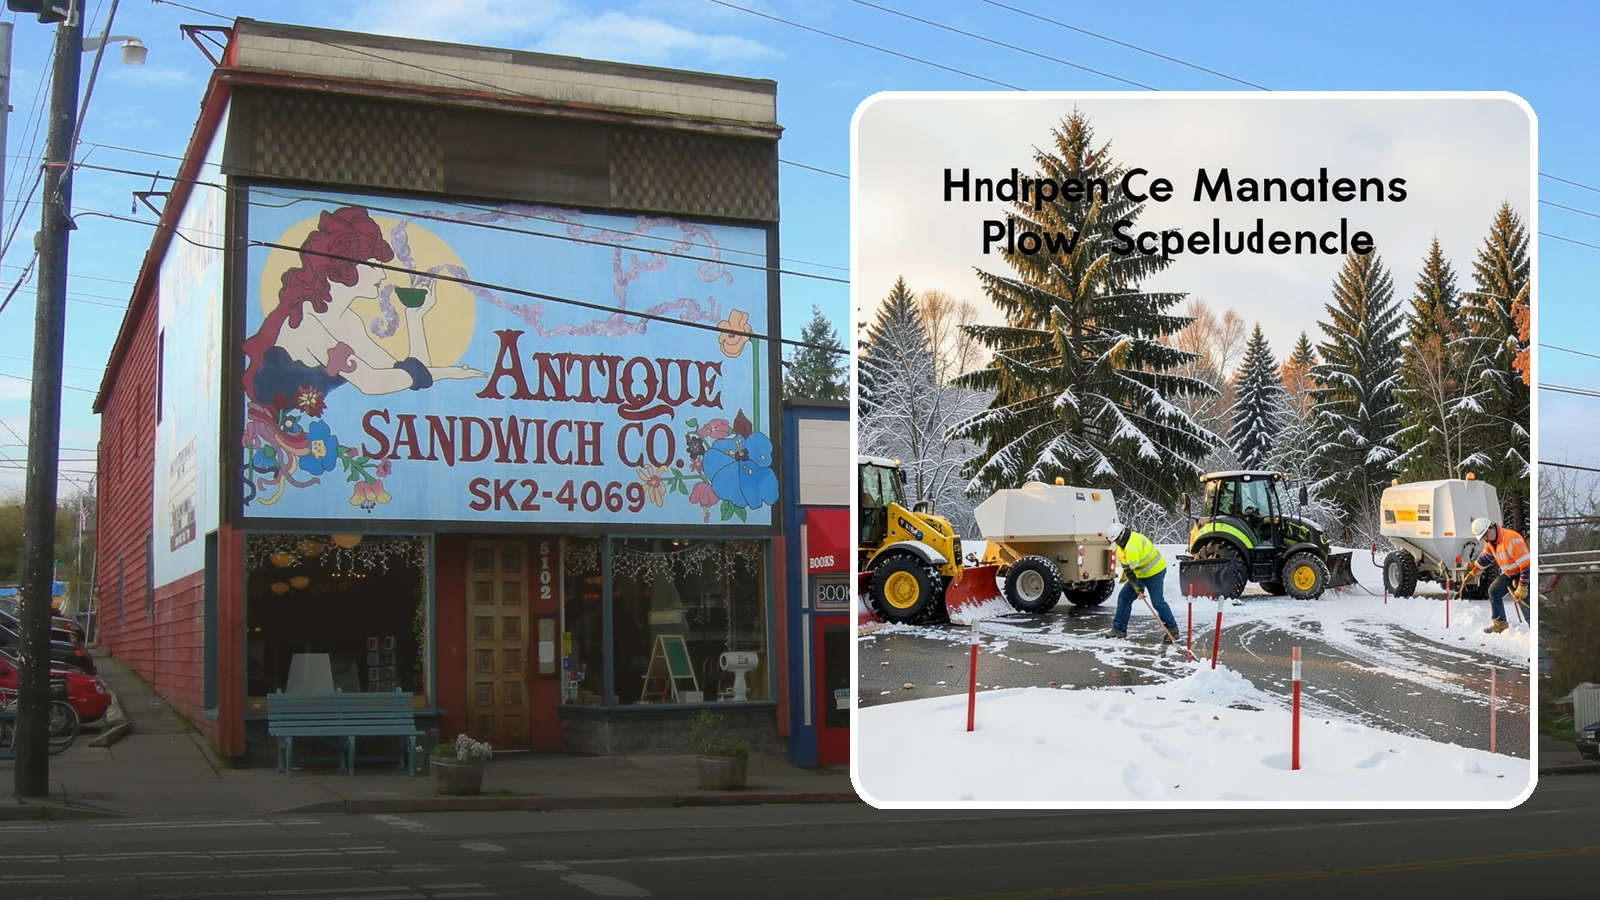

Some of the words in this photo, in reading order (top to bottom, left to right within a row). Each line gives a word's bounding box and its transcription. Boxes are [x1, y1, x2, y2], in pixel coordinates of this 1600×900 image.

[475, 328, 725, 421] ANTIQUE
[361, 408, 605, 468] SANDWICH
[616, 421, 686, 469] CO.
[467, 477, 647, 514] SK2-4069
[540, 541, 552, 600] 5102
[809, 555, 834, 568] BOOKS
